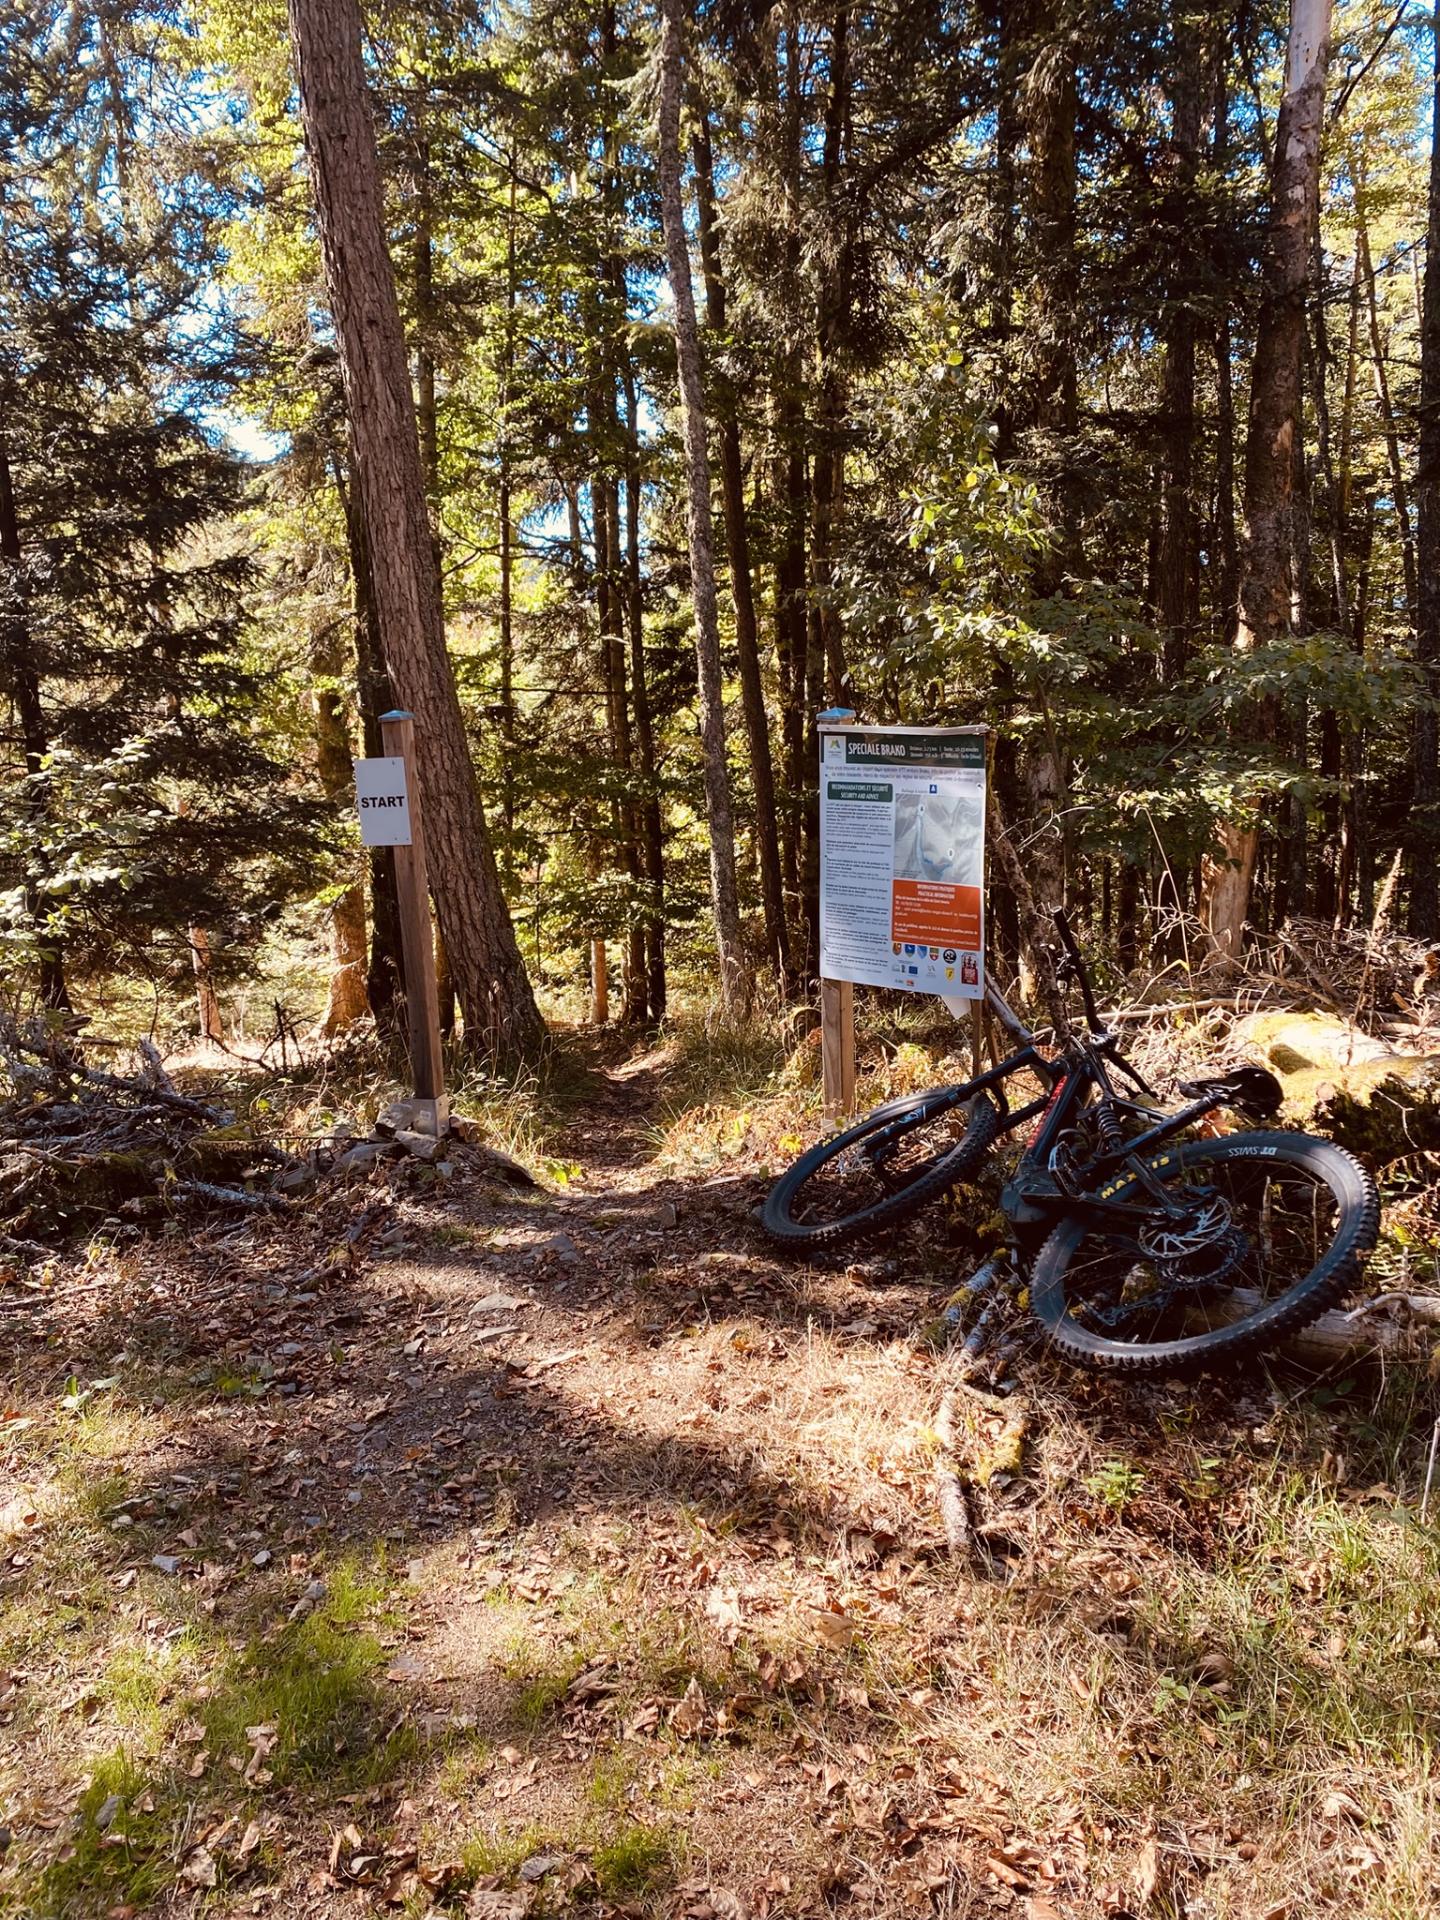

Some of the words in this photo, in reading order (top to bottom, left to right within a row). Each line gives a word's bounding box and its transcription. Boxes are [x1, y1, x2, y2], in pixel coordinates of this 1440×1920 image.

[848, 743, 880, 755] SPECIALE
[880, 744, 906, 757] BRAKO
[361, 796, 405, 808] START
[1228, 1146, 1259, 1157] SWISS
[1260, 1146, 1278, 1156] DT
[1101, 1155, 1170, 1200] MAXIS
